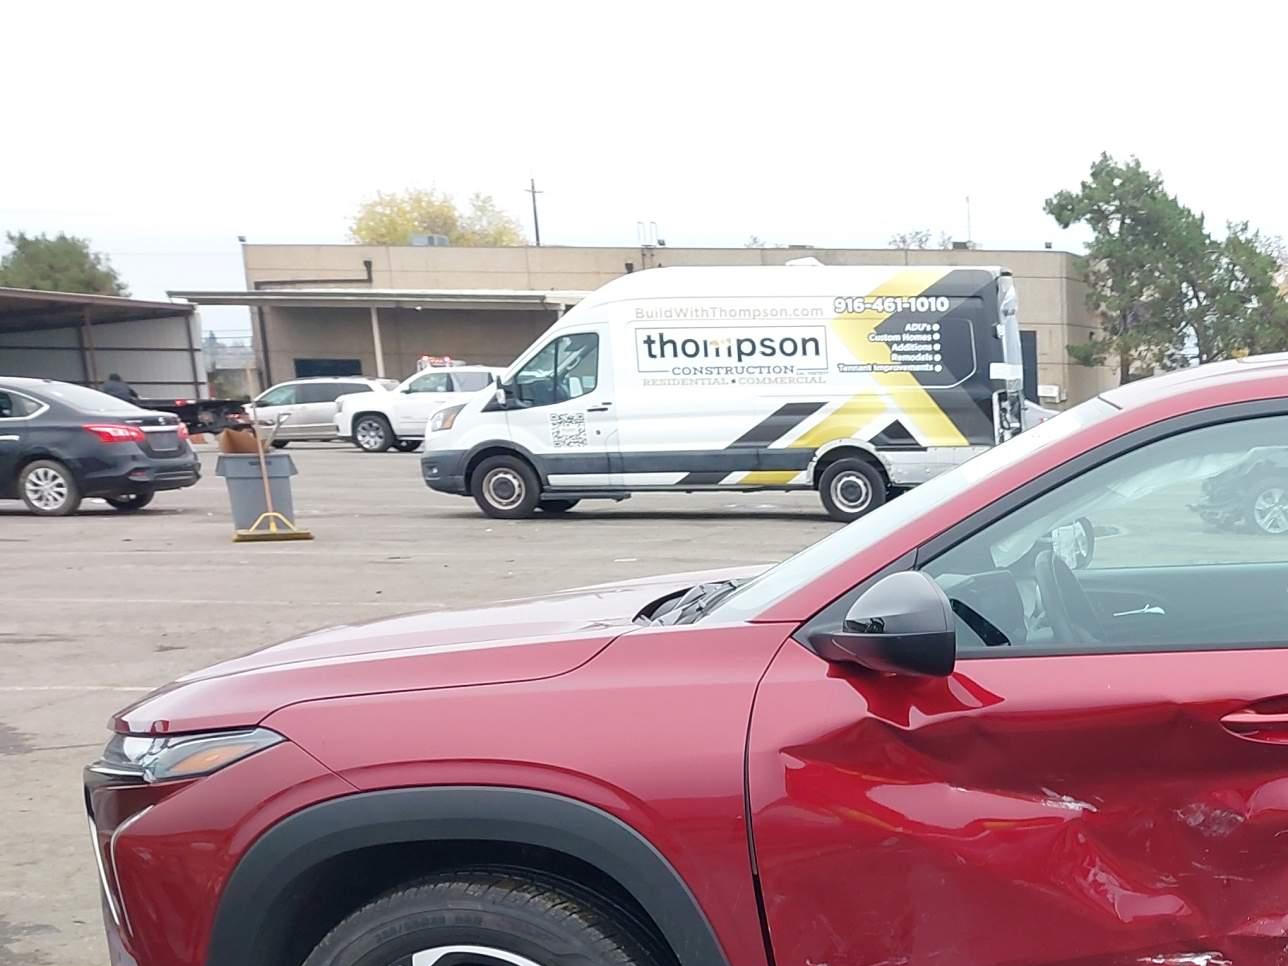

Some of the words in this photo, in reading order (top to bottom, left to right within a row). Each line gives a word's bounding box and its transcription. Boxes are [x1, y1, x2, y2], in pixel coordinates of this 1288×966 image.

[833, 296, 950, 313] 916-461-1010
[634, 306, 825, 320] BuildWithThompson.com
[868, 333, 901, 342] Custom
[901, 332, 932, 342] Homes
[642, 332, 821, 363] thompson
[891, 343, 933, 352] Additions
[891, 353, 933, 362] Remodels
[671, 365, 795, 376] CONSTRUCTION
[642, 377, 729, 387] RESIDENTIAL
[738, 375, 827, 386] COMMERCIAL
